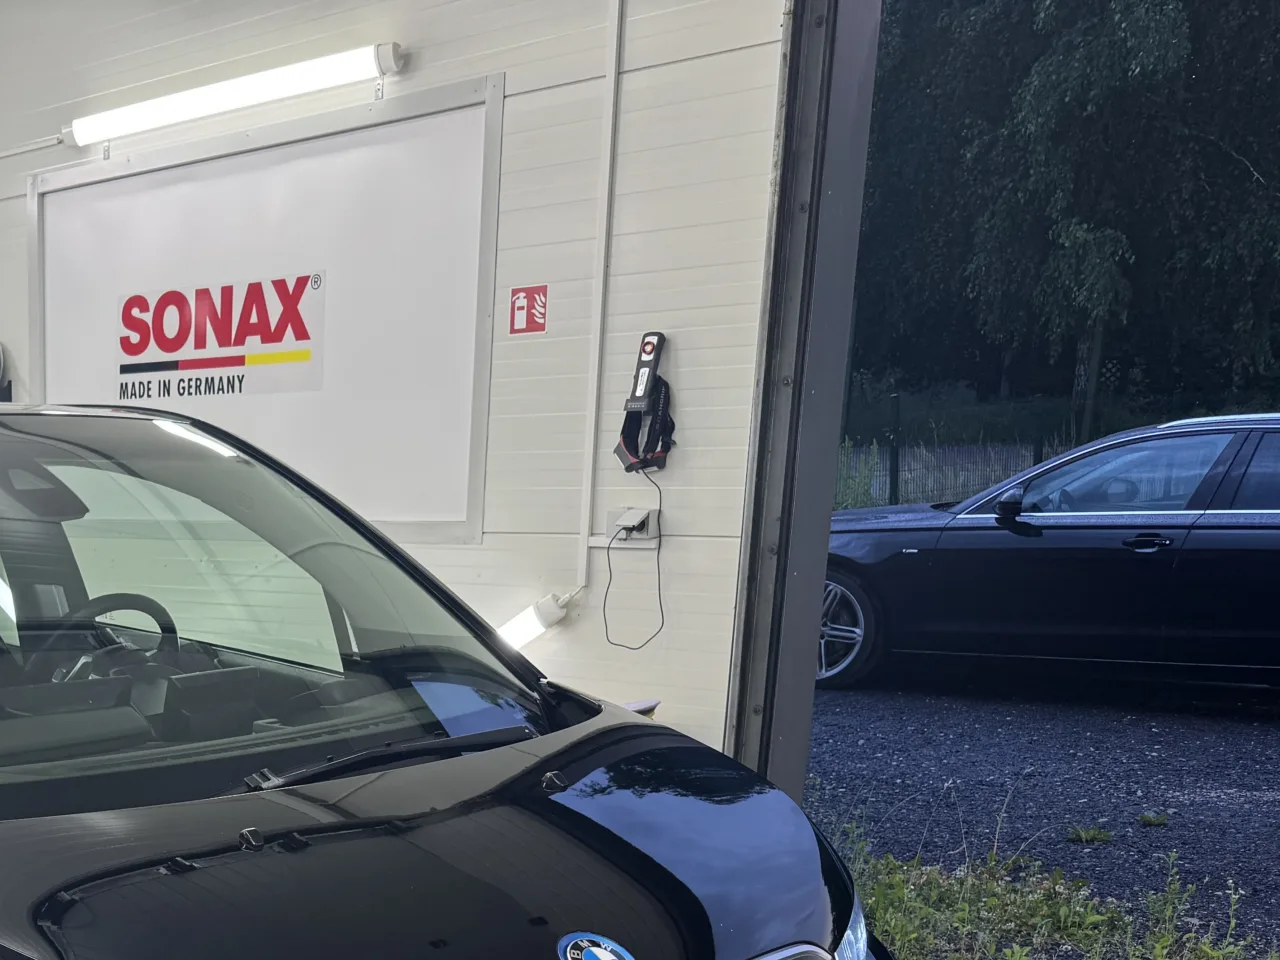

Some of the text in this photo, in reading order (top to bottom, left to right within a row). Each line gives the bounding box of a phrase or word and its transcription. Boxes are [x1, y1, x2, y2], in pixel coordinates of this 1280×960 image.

[119, 374, 245, 401] MADE IN GERMANY
